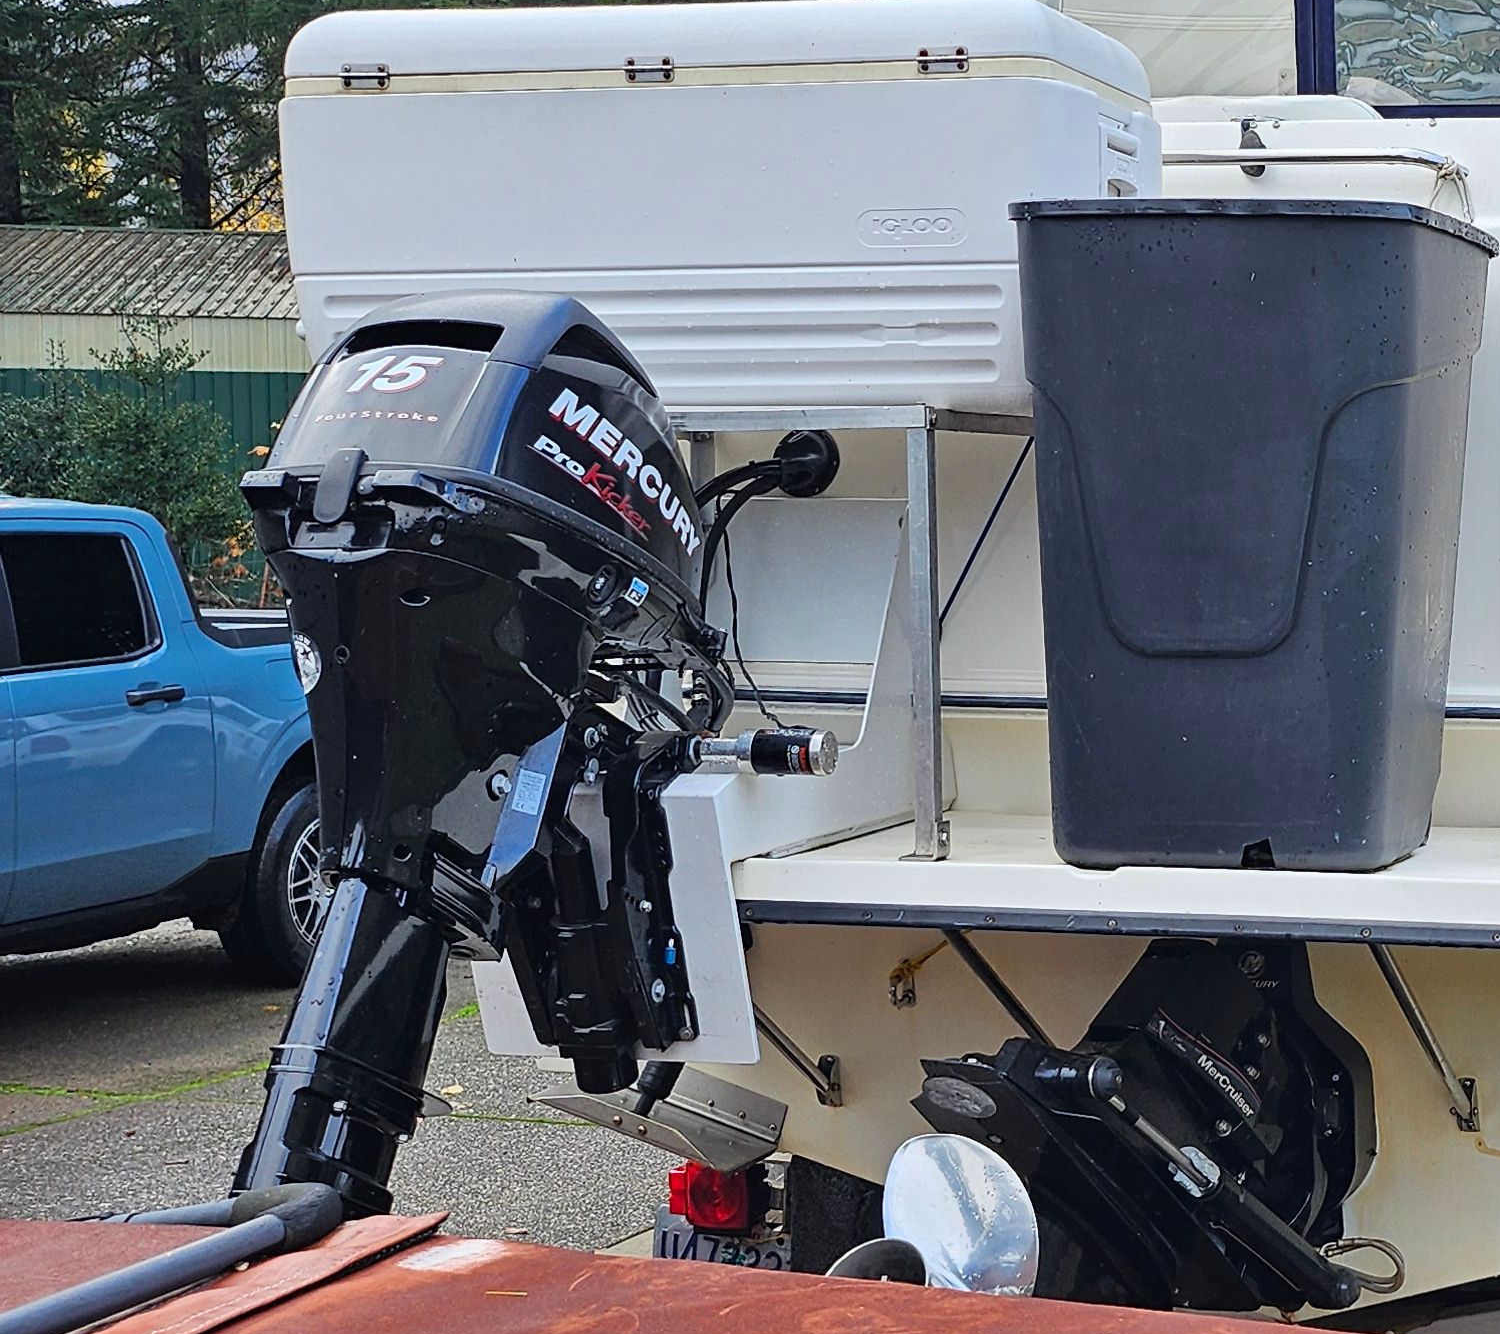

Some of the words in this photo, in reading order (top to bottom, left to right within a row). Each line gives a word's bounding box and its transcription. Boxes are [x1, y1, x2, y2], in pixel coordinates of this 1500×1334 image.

[872, 217, 954, 239] IGLOO
[345, 355, 446, 394] 15
[533, 435, 651, 531] ProKicker
[549, 387, 701, 557] MERCURY
[1197, 1054, 1254, 1116] MerCruiser
